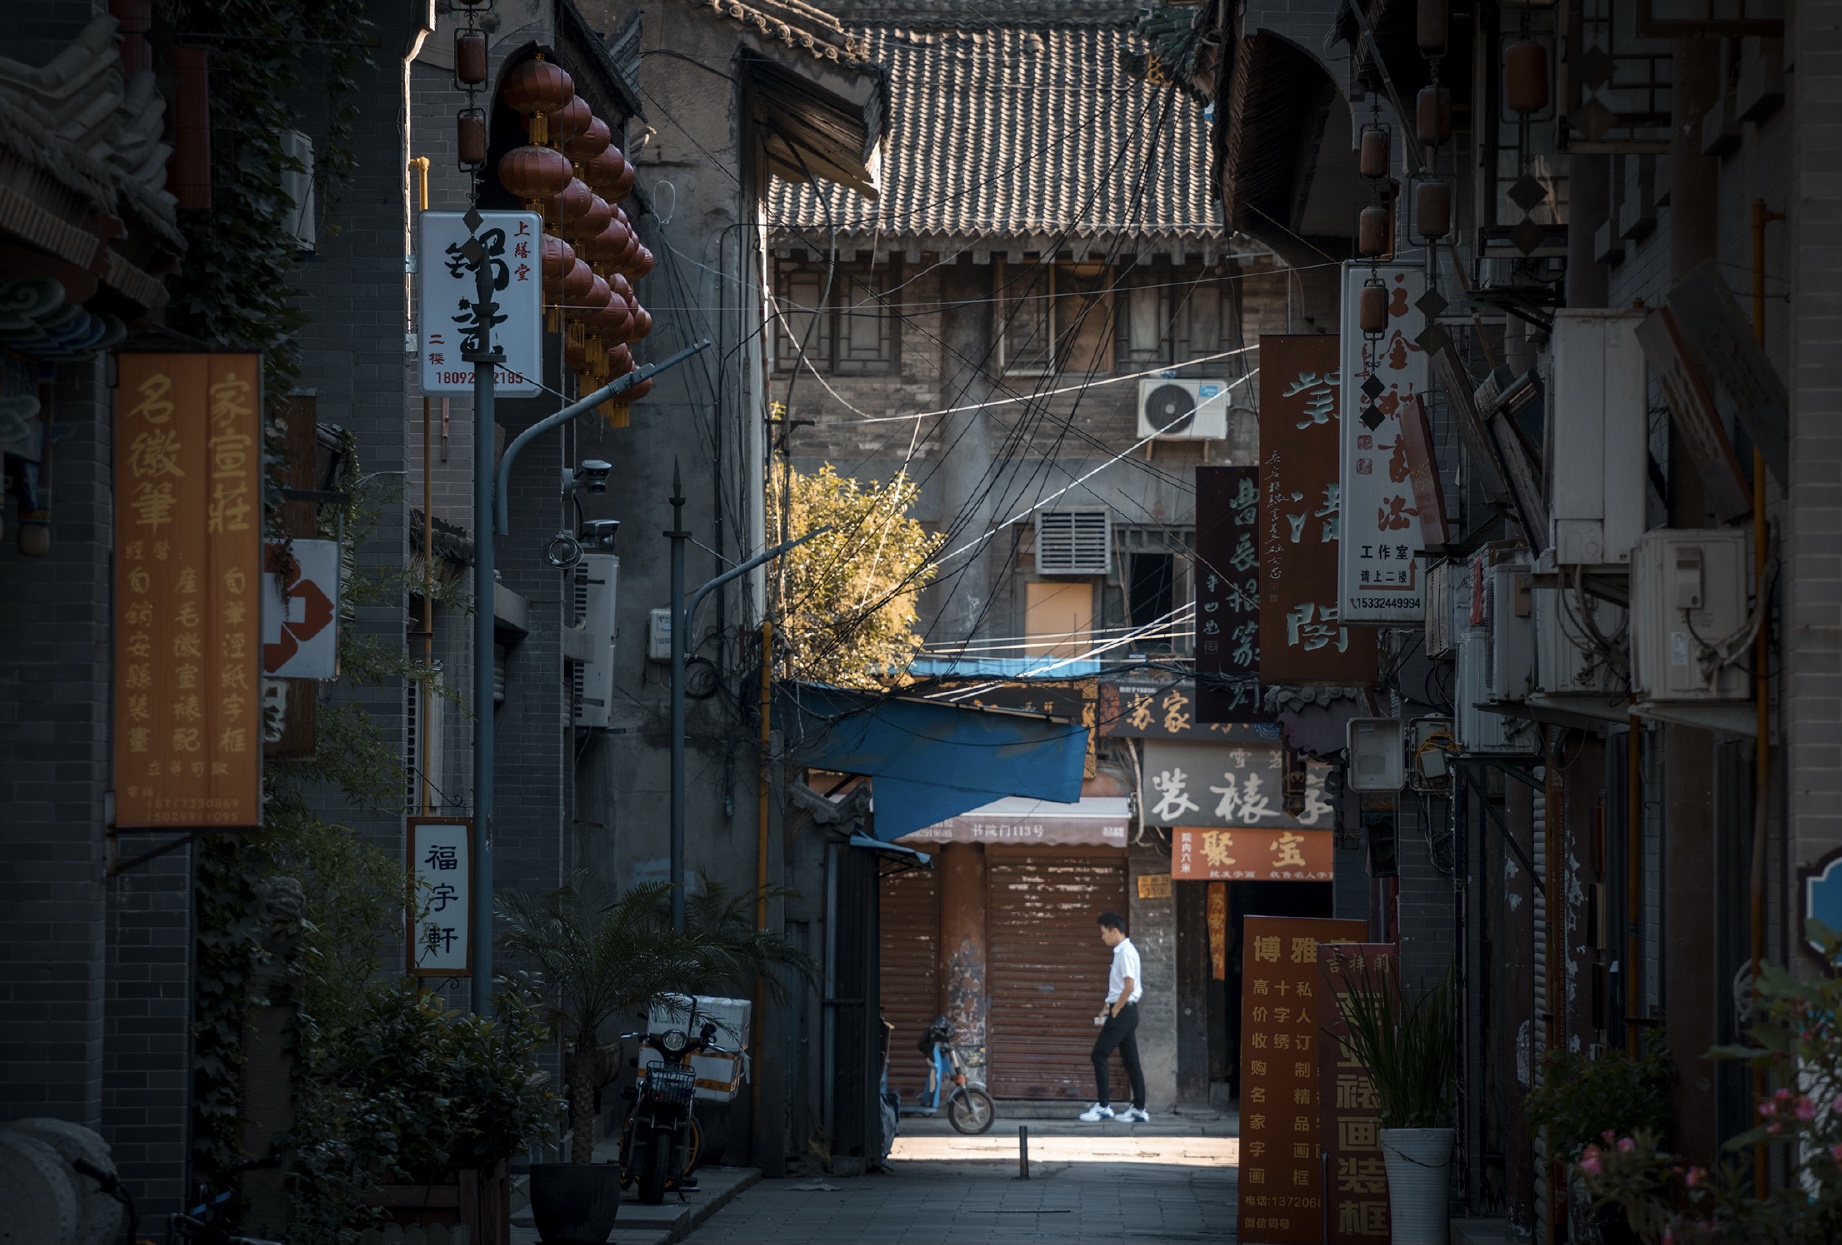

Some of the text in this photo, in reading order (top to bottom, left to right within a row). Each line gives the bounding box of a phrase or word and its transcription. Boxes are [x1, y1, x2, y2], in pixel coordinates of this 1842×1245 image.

[436, 372, 523, 384] 180922185
[1361, 545, 1408, 560] 工作室
[1361, 570, 1407, 583] 请上二楼
[1356, 598, 1421, 609] 15332449994
[972, 823, 1045, 838] 书院门113号
[1200, 830, 1305, 867] 聚宝
[1274, 980, 1290, 1050] 十字绣
[1249, 979, 1269, 1184] 高价收购名家字画
[1292, 981, 1313, 1186] 私人订制精品画框
[1244, 1217, 1290, 1230] 微信同号
